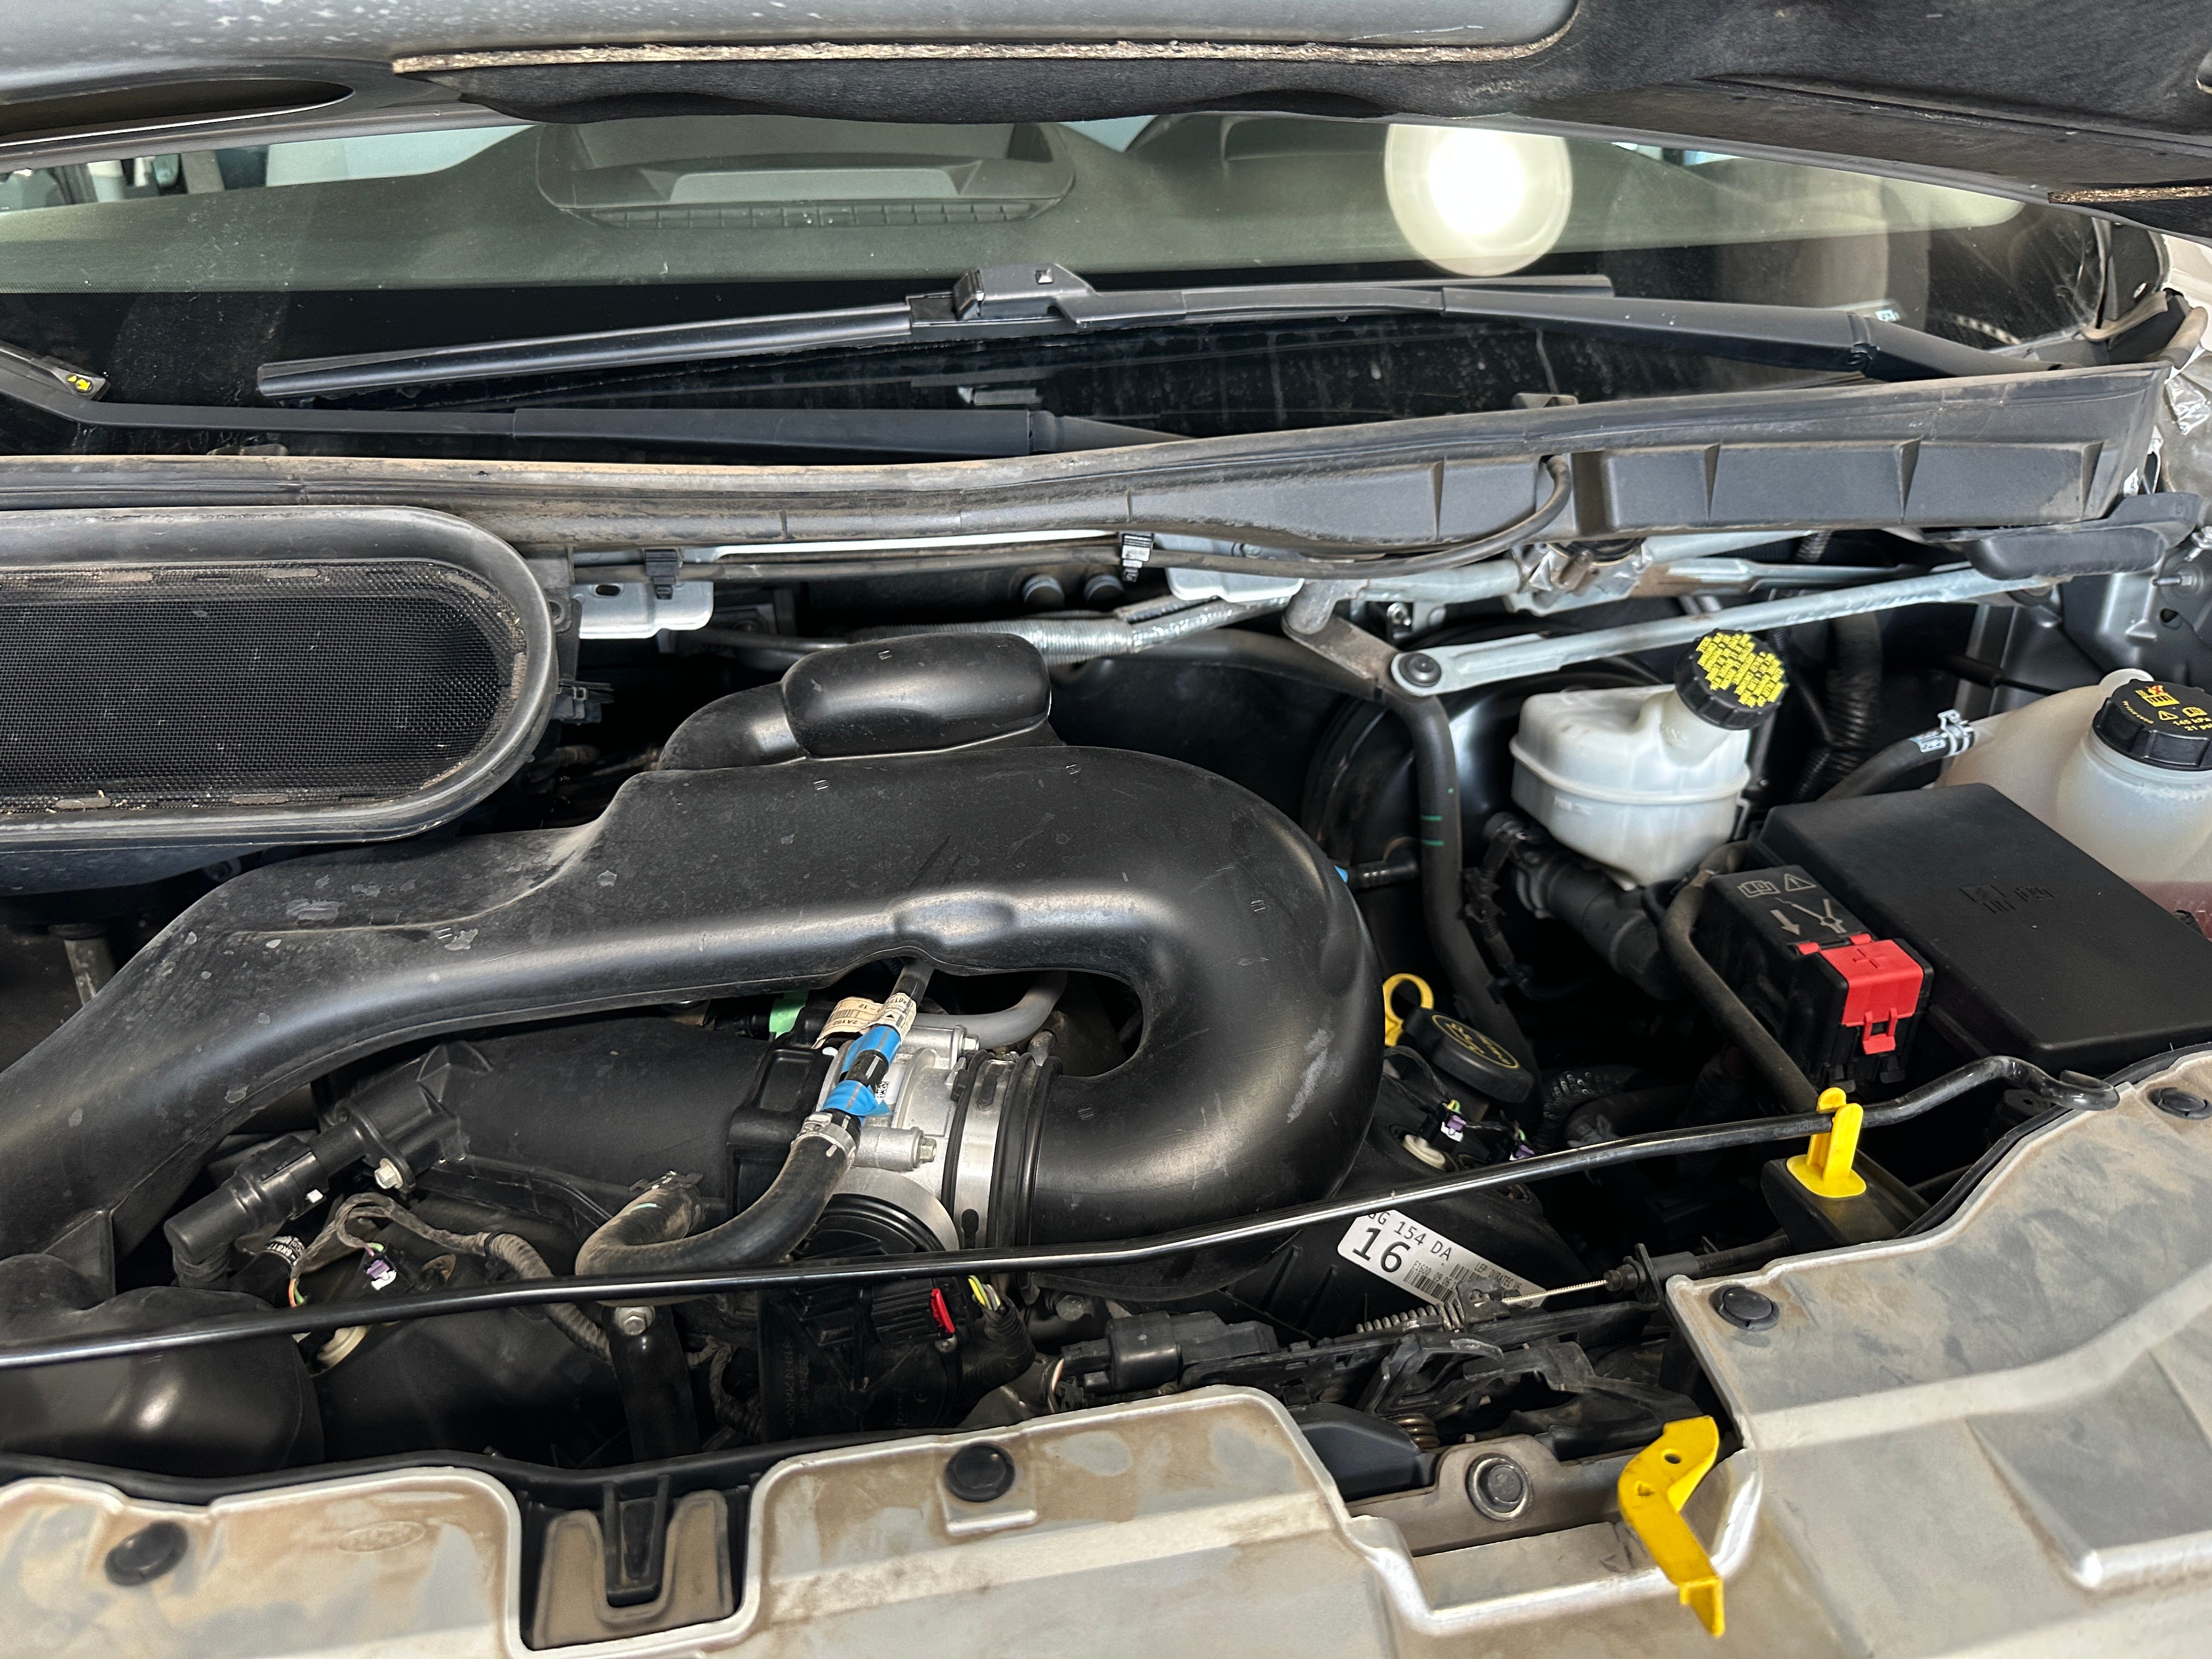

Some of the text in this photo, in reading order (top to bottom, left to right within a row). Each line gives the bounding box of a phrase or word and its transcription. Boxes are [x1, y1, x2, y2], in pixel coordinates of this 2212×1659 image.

[1352, 1227, 1411, 1273] 16
[1393, 1221, 1427, 1245] 154
[1430, 1240, 1452, 1261] DA
[1412, 1260, 1432, 1276] E1600
